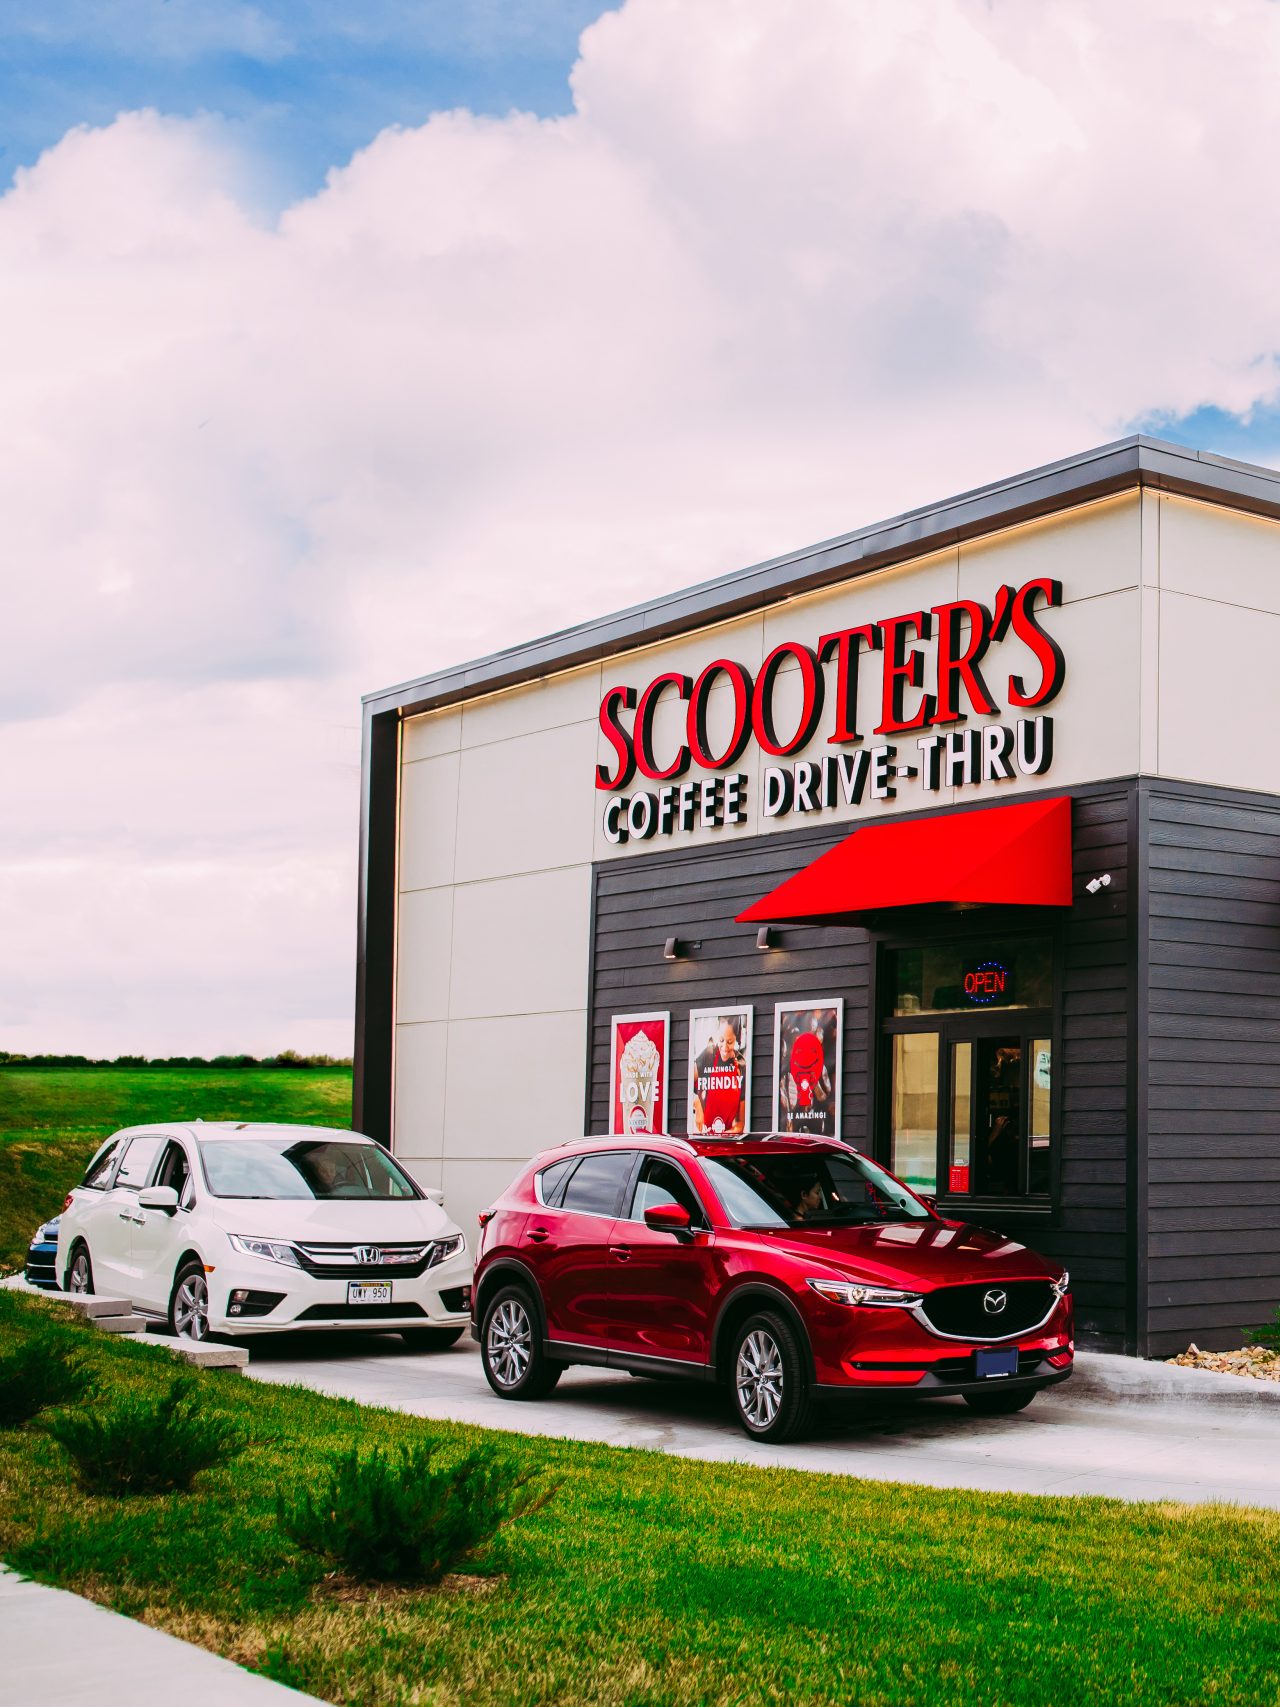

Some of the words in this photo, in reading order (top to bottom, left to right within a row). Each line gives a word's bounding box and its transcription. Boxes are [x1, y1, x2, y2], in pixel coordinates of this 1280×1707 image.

[595, 578, 1064, 791] SCOOTER'S
[603, 773, 748, 844] COFFEE
[763, 716, 1054, 817] DRIVE-THRU
[964, 971, 1005, 993] OPEN
[703, 1065, 736, 1074] AMAZINGLY
[620, 1081, 660, 1103] LOVE
[697, 1075, 744, 1091] FRIENDLY
[795, 1111, 827, 1119] AMAZING!
[373, 1288, 387, 1298] 950
